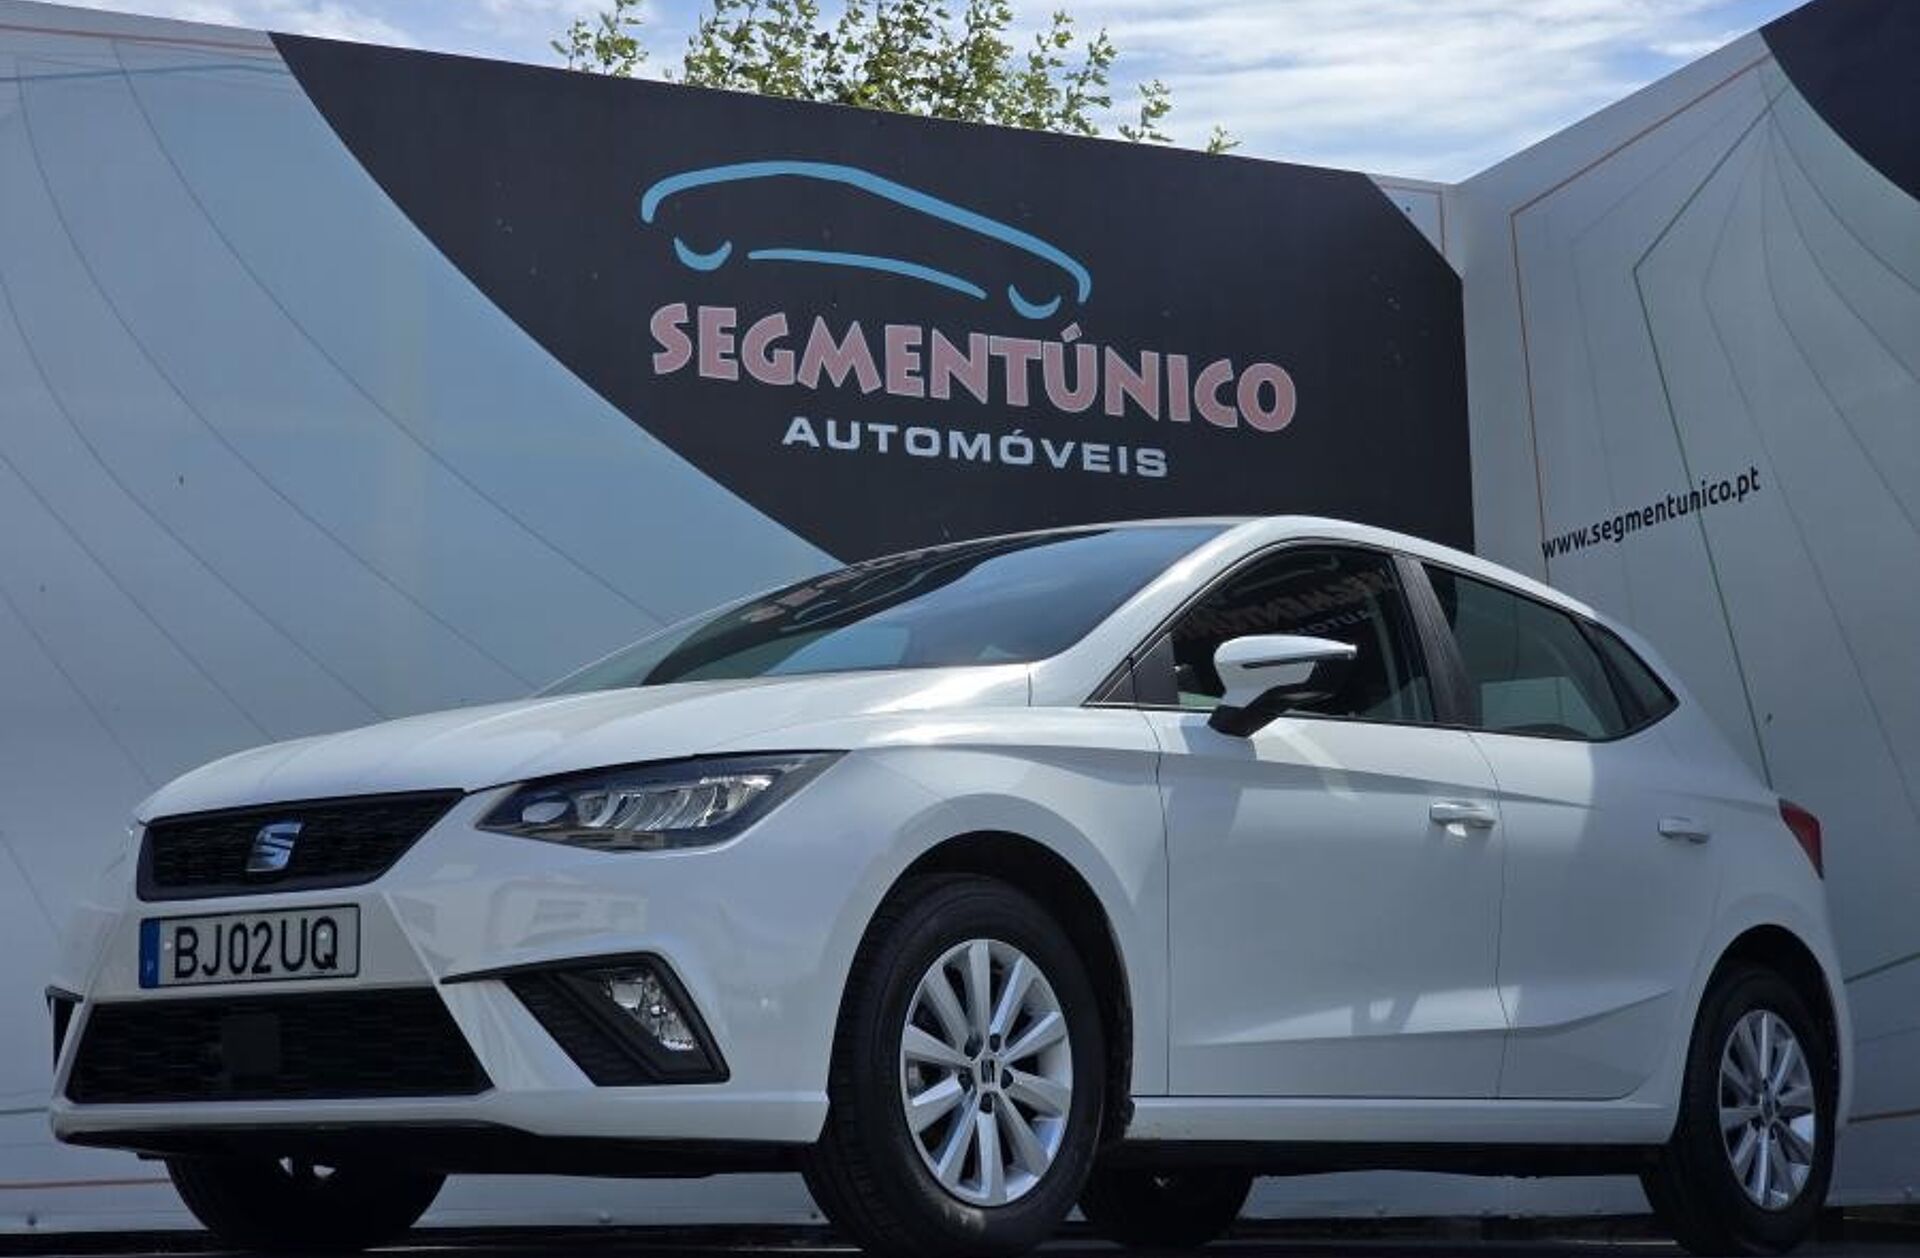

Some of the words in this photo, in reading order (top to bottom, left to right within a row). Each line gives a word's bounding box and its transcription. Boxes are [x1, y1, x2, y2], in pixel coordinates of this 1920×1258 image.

[650, 302, 1297, 433] SEGMENTÚNICO
[782, 416, 1169, 478] AUTOMÓVEIS
[1541, 465, 1761, 559] www.segmentunico.pt
